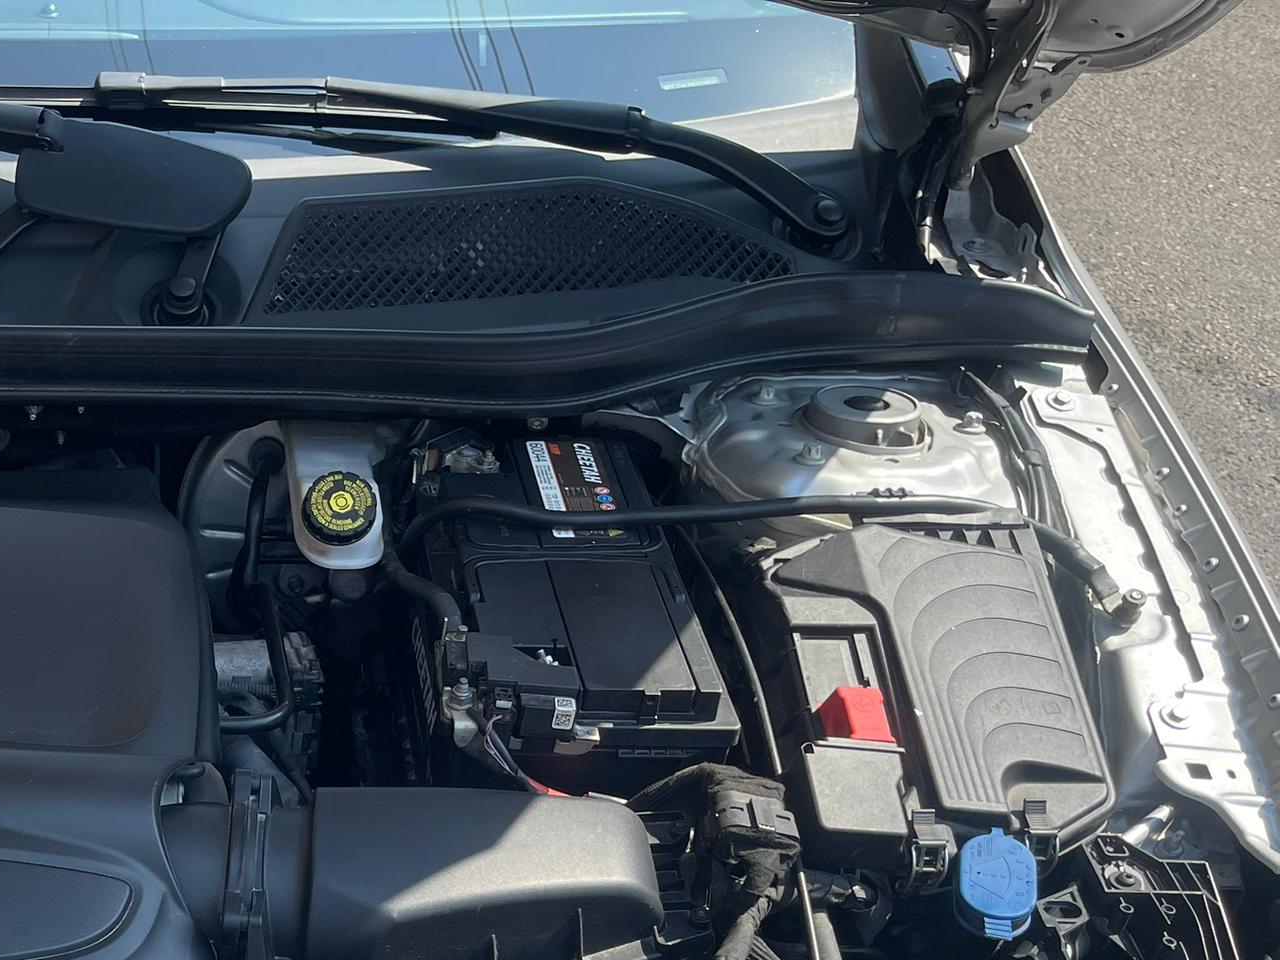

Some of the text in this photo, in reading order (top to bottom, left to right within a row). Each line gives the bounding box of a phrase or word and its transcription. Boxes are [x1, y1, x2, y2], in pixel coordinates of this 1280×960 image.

[529, 443, 547, 462] 60044
[573, 443, 603, 484] CHEETAH
[411, 616, 438, 737] CHEETAH
